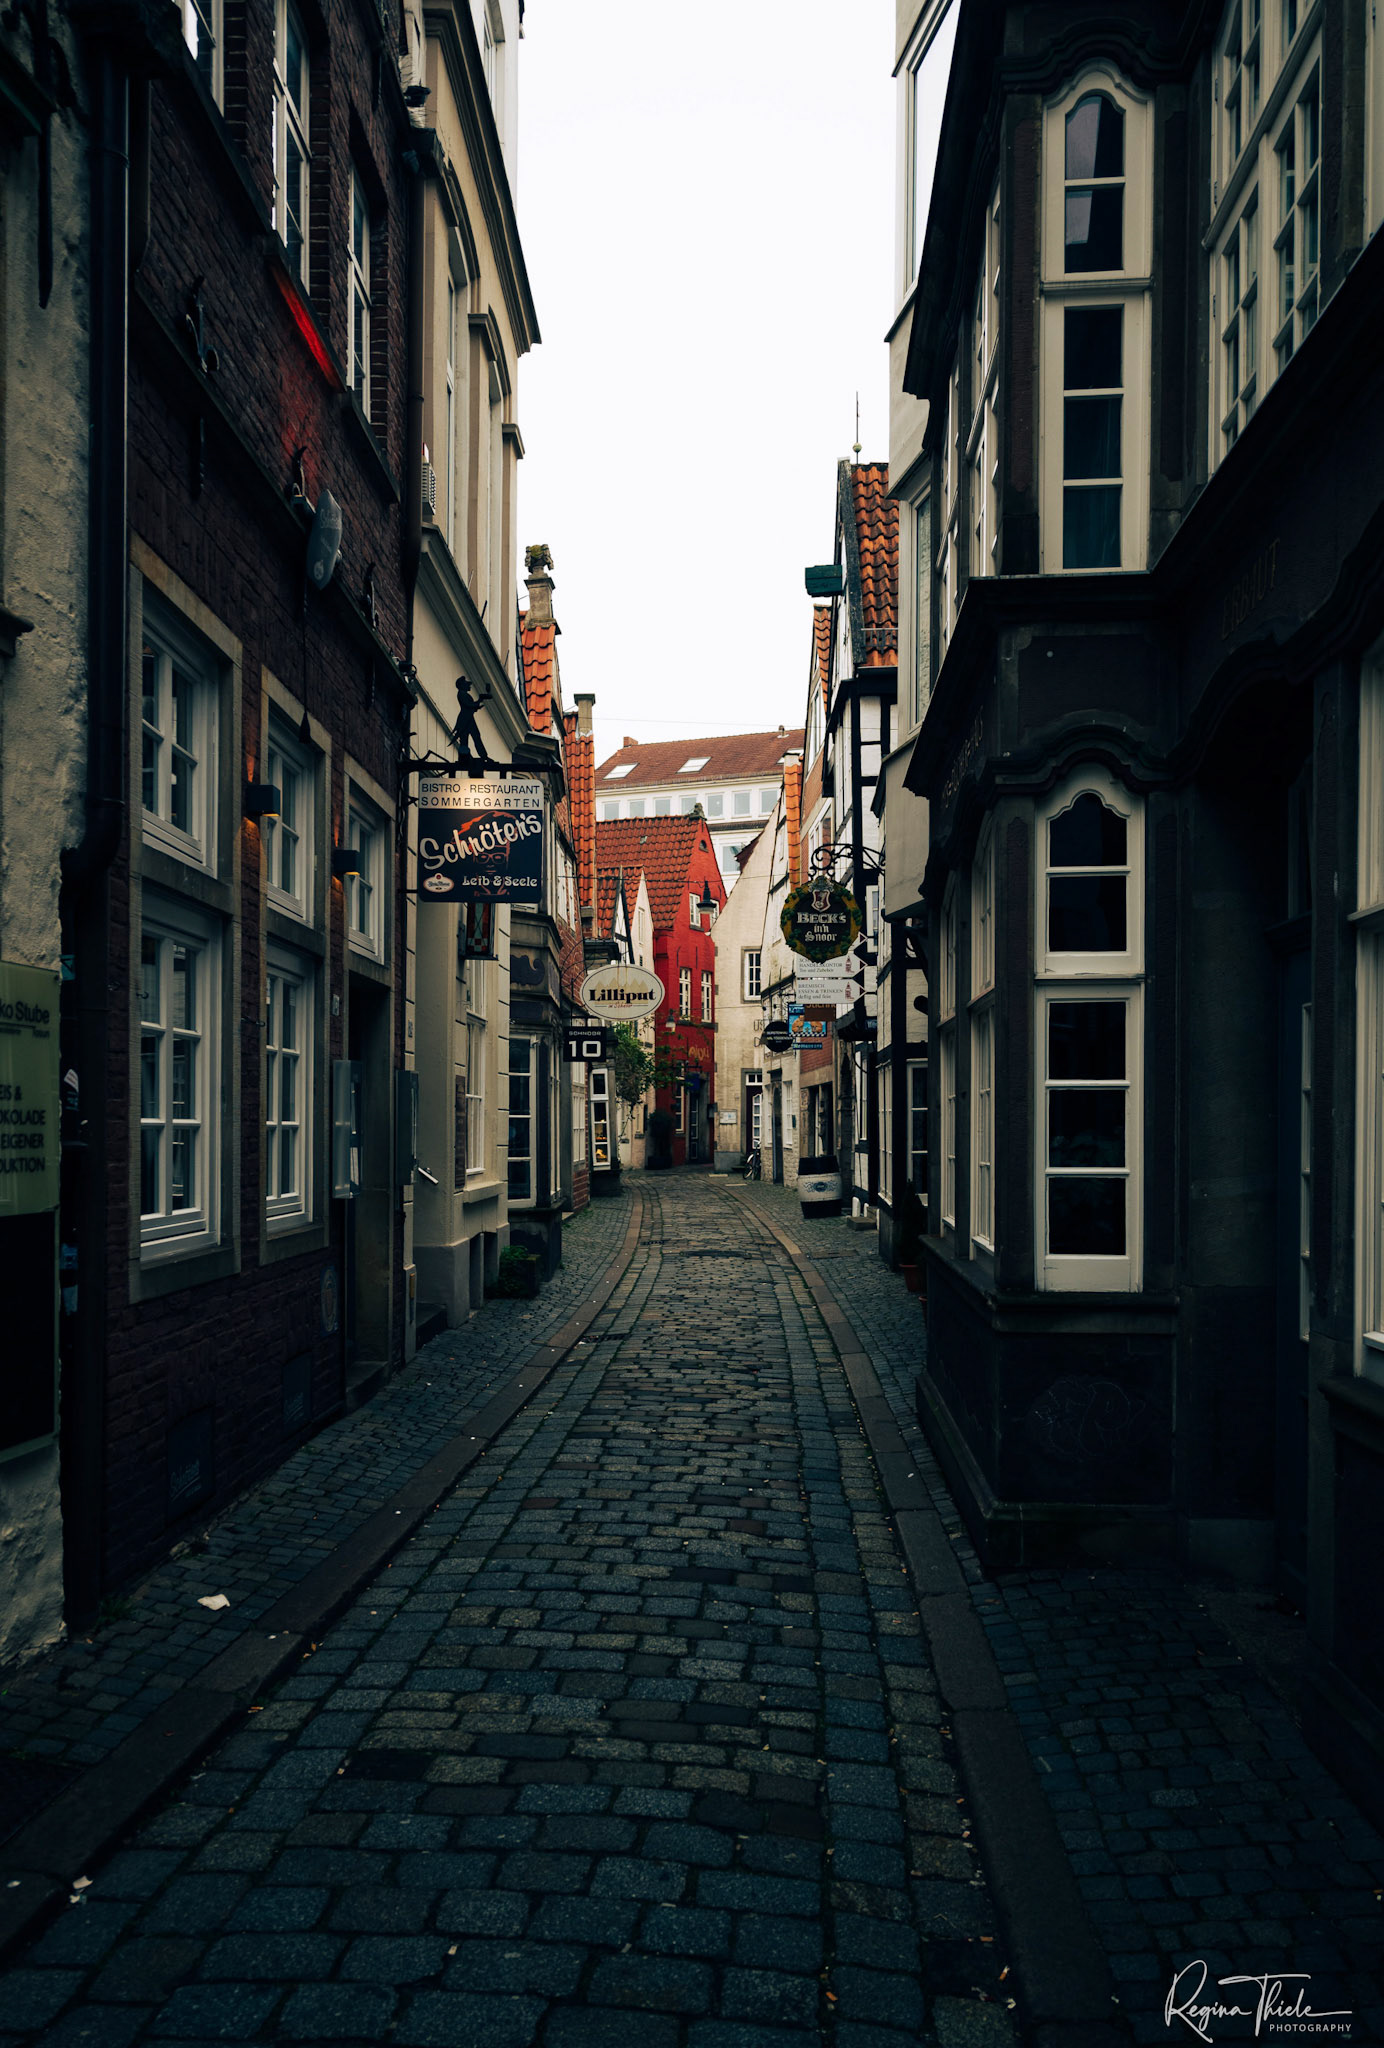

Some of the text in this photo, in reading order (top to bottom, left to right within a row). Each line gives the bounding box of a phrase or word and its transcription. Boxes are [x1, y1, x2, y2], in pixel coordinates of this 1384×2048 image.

[421, 783, 461, 793] BISTRO
[470, 784, 540, 795] RESTAURANT
[421, 797, 540, 808] SOMMERGARTEN
[420, 813, 542, 870] Schröter's
[462, 875, 490, 886] Leib
[493, 876, 502, 886] &
[504, 876, 538, 887] Seele
[804, 931, 837, 942] Snoor
[588, 989, 656, 1004] Lilliput
[16, 1001, 50, 1025] Stube
[568, 1040, 602, 1058] 10
[15, 1085, 21, 1101] &
[1, 1132, 44, 1149] EIGENER
